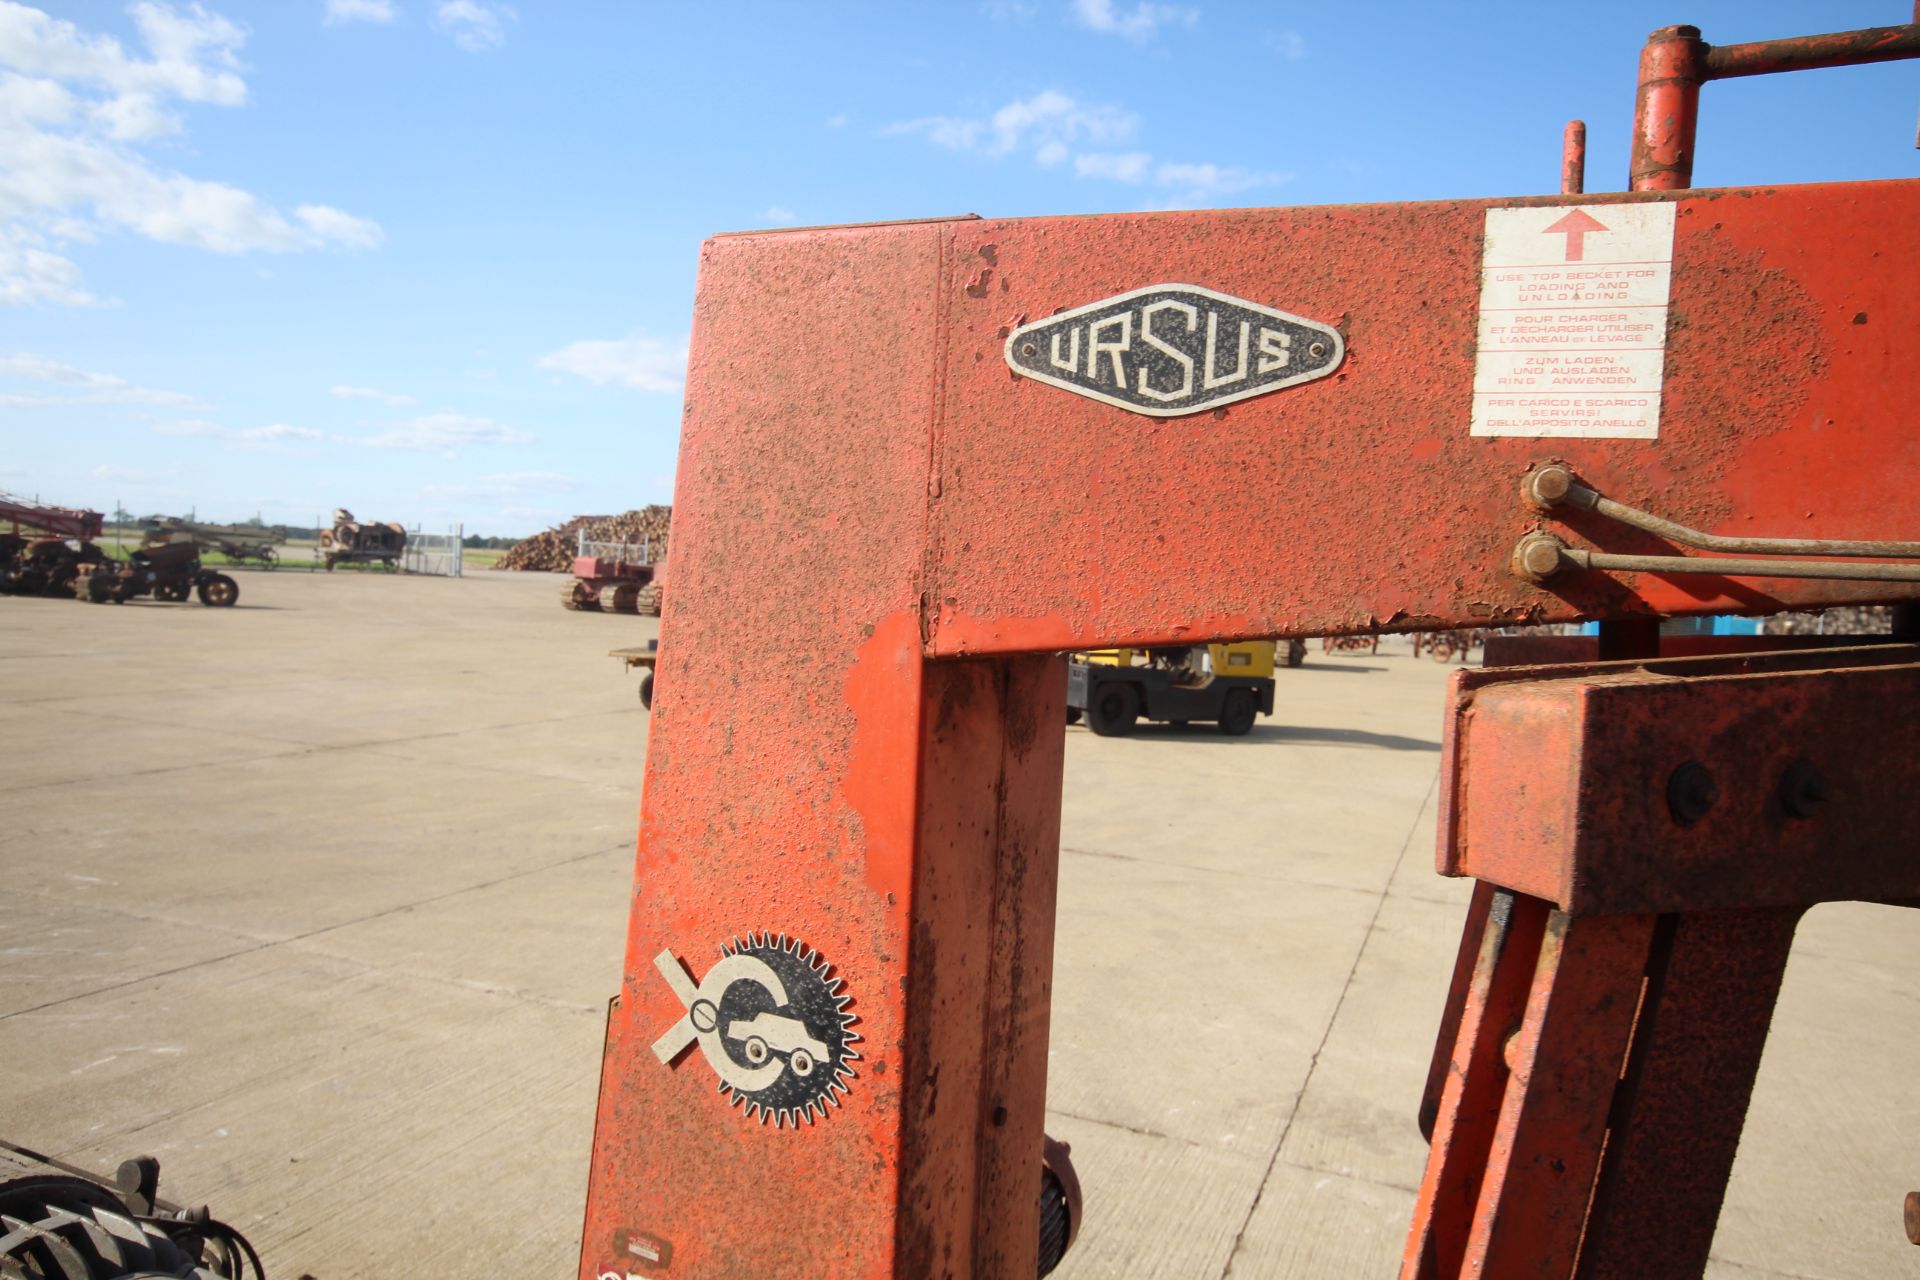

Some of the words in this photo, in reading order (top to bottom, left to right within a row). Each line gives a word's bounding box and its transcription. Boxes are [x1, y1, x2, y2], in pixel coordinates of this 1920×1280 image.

[1496, 273, 1524, 282] USE
[1532, 272, 1560, 281] TOP
[1566, 270, 1623, 280] BECKET
[1626, 269, 1657, 279] FOR
[1519, 282, 1586, 292] LOADING
[1596, 281, 1630, 290] AND
[1519, 291, 1629, 302] UNLOADING
[1514, 315, 1553, 324] POUR
[1558, 314, 1628, 323] CHARGER
[1490, 326, 1506, 334] ET
[1510, 325, 1594, 334] DECHARGER
[1597, 323, 1655, 333] UTILISER
[1499, 335, 1569, 344] L'ANNEAU
[1590, 334, 1644, 343] LEVAGE
[1051, 298, 1292, 402] URSUS
[1525, 357, 1559, 365] ZUM
[1565, 356, 1615, 365] LADEN
[1513, 367, 1544, 375] UND
[1551, 366, 1631, 375] AUSLADEN
[1498, 377, 1536, 385] RING
[1552, 376, 1637, 385] ANWENDEN
[1488, 399, 1516, 407] PER
[1519, 399, 1570, 407] CARICO
[1574, 399, 1582, 407] E
[1585, 399, 1648, 407] SCARICO
[1530, 409, 1601, 417] SERVIRSI
[1487, 419, 1591, 428] DELL'APPOSITO
[1592, 419, 1647, 428] ANELLO
